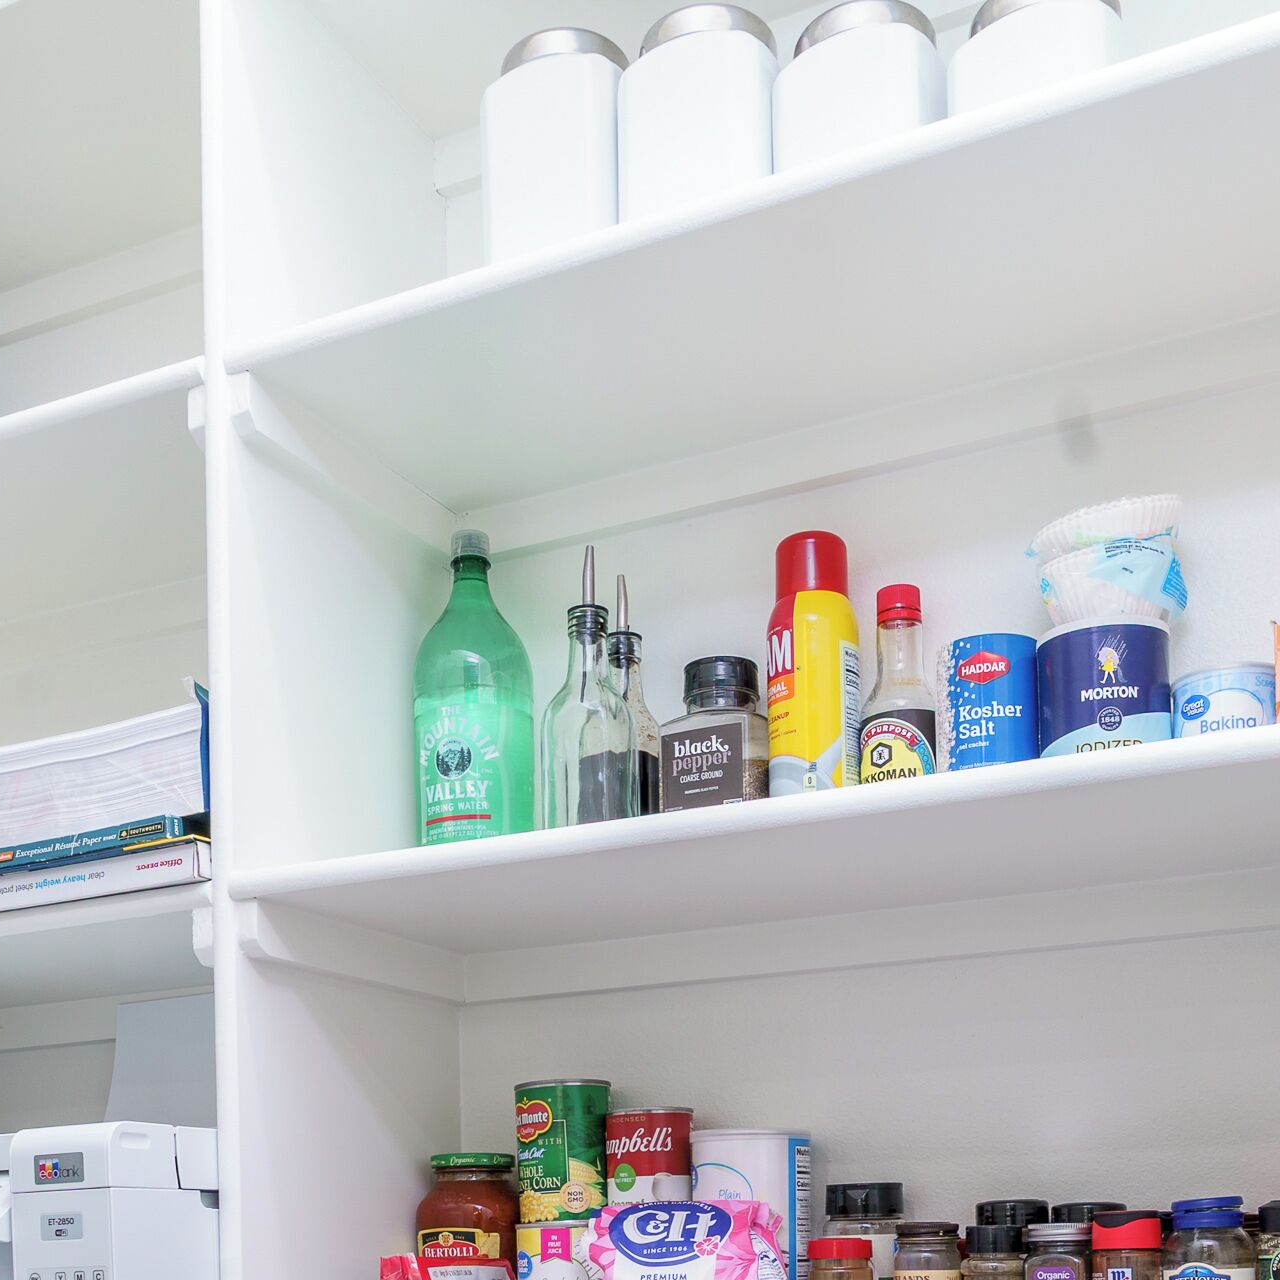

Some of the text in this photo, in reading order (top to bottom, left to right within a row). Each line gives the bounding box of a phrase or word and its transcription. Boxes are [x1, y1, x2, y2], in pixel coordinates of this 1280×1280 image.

[961, 661, 1006, 676] HADDAR
[1081, 686, 1138, 702] MORTON
[441, 705, 461, 715] THE
[959, 701, 1022, 722] Kosher
[1183, 699, 1205, 713] Great
[1100, 716, 1120, 724] 1848
[959, 721, 995, 739] Salt
[420, 717, 500, 766] MOUNTAIN
[673, 734, 730, 758] black
[672, 750, 732, 776] pepper
[680, 770, 723, 783] COARSE GROUND
[426, 780, 489, 803] VALLEY
[427, 800, 488, 816] SPRING WATER
[129, 822, 162, 836] SOUTHWORTH
[15, 835, 102, 858] Exceptional Paper
[159, 858, 183, 868] Office
[62, 873, 86, 885] heavy
[88, 871, 105, 881] clear
[16, 881, 34, 891] sheet
[35, 876, 61, 890] weight
[521, 1111, 548, 1124] Monte
[537, 1137, 562, 1146] WITH
[449, 1156, 476, 1166] Organic
[39, 1164, 80, 1180] ecotank
[533, 1176, 561, 1189] CORN
[718, 1188, 741, 1200] Plain
[48, 1217, 75, 1226] ET-2850
[622, 1209, 717, 1245] C&H
[424, 1246, 474, 1257] BERTOLLI
[643, 1247, 667, 1255] SINCE
[1036, 1271, 1070, 1280] Organic
